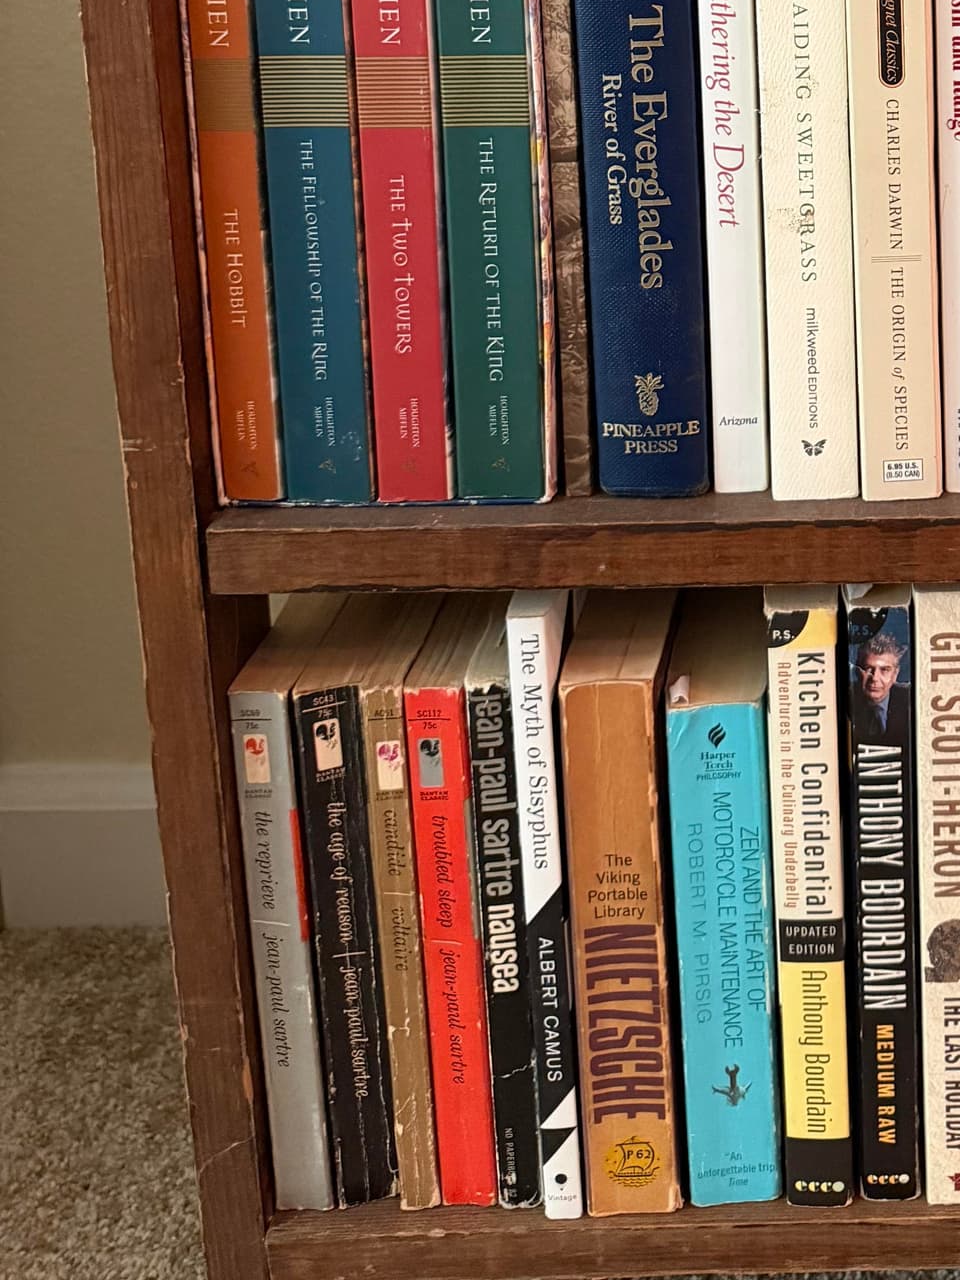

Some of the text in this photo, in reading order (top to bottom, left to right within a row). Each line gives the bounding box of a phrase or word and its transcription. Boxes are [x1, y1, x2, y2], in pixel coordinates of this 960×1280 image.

[711, 96, 740, 136] the
[713, 144, 746, 228] Desert
[886, 99, 904, 251] CHARLES DARWIN
[223, 209, 245, 328] THE HOBBIT
[602, 422, 700, 438] PINEAPPLE
[719, 414, 759, 427] Arizona
[624, 439, 679, 454] PRESS
[772, 629, 795, 640] P.S.
[520, 634, 552, 870] The Myth of Sisyphus
[798, 652, 833, 916] Kitchen Confidential
[605, 854, 633, 866] The
[596, 871, 641, 887] Viking
[587, 888, 648, 904] Portable
[593, 905, 645, 920] Library
[785, 925, 837, 938] UPDATED
[788, 943, 835, 955] EDITION
[538, 936, 564, 1083] ALBERT CAMUS
[583, 924, 666, 1125] NIETZSCHE
[798, 970, 833, 1134] Anthony Bourdain
[876, 1024, 897, 1145] MEDIUM RAW
